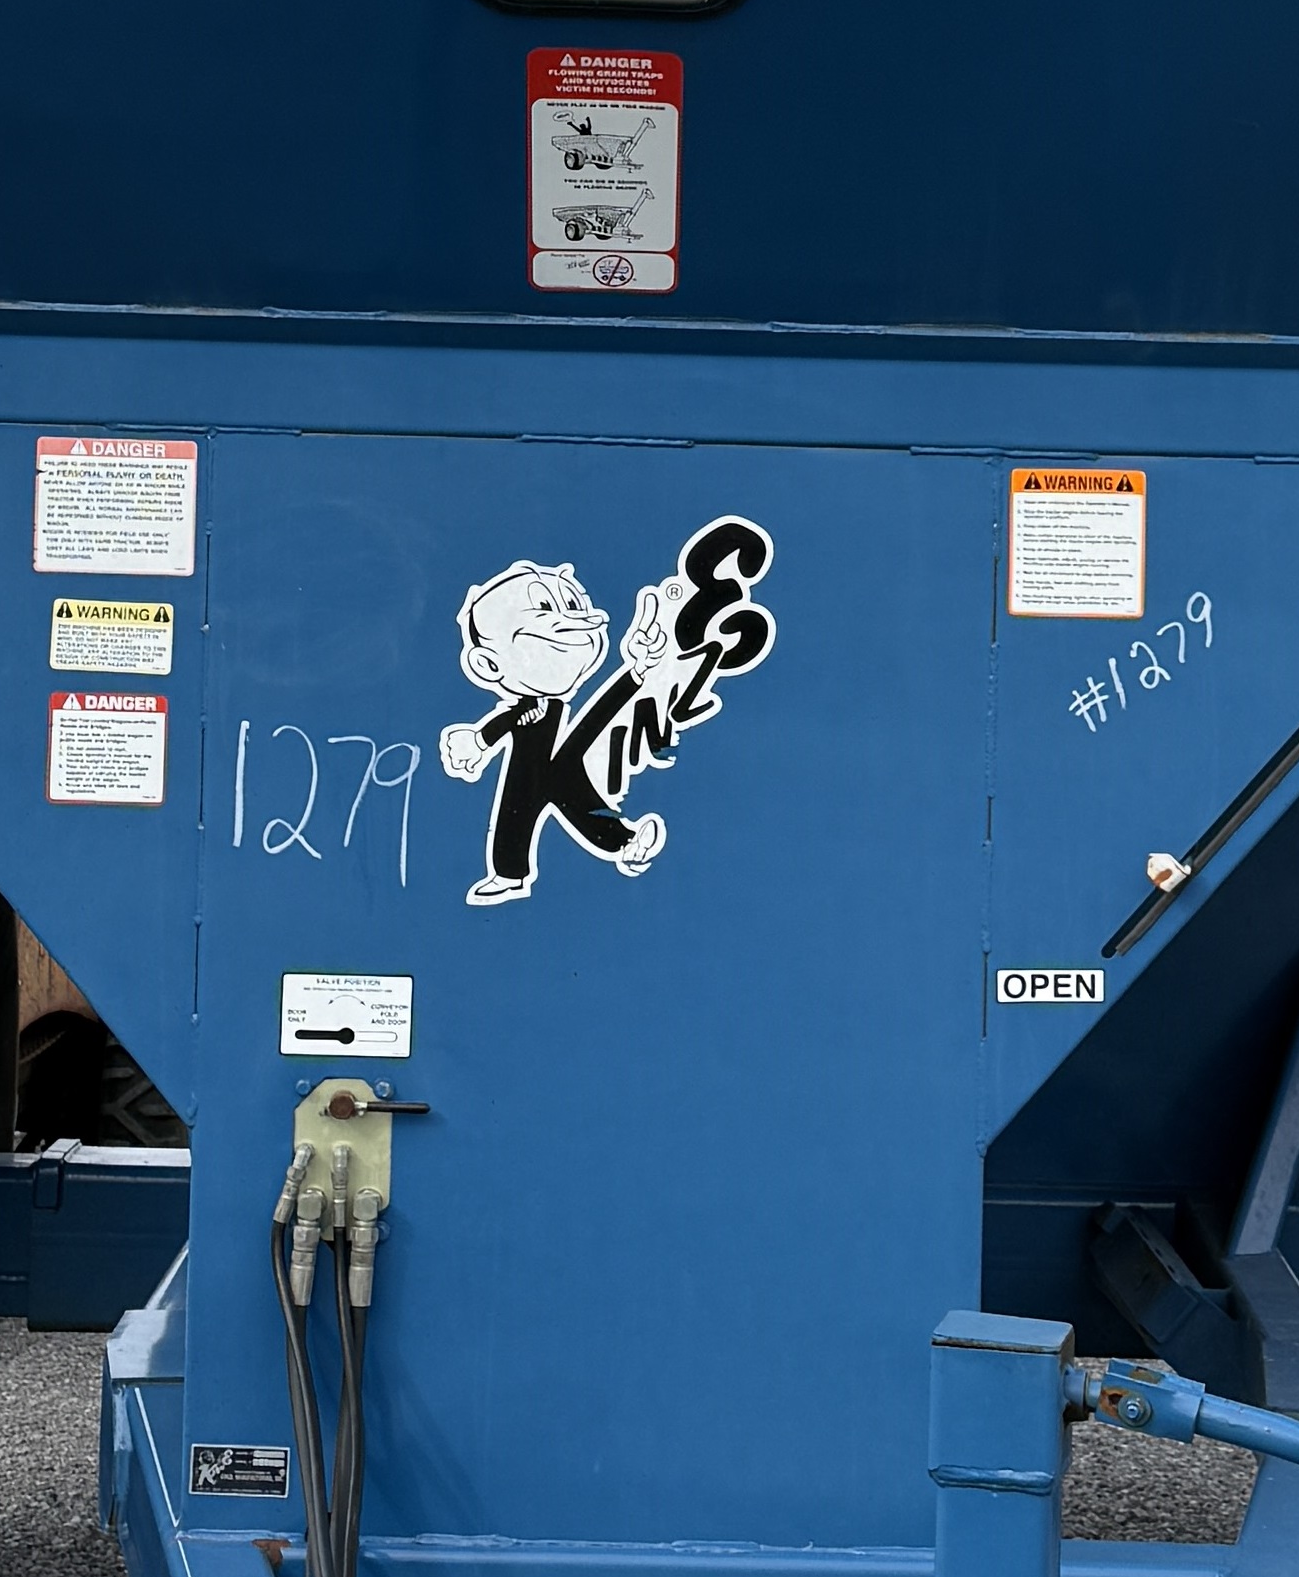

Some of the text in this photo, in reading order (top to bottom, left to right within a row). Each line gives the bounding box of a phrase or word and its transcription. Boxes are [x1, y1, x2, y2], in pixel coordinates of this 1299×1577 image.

[580, 56, 653, 70] DANGER
[92, 442, 166, 458] DANGER
[1043, 475, 1113, 492] WARNING
[76, 604, 150, 622] WARNING
[1068, 591, 1214, 732] #1279
[85, 694, 157, 712] DANGER
[232, 719, 421, 888] 1279
[1002, 973, 1097, 1000] OPEN
